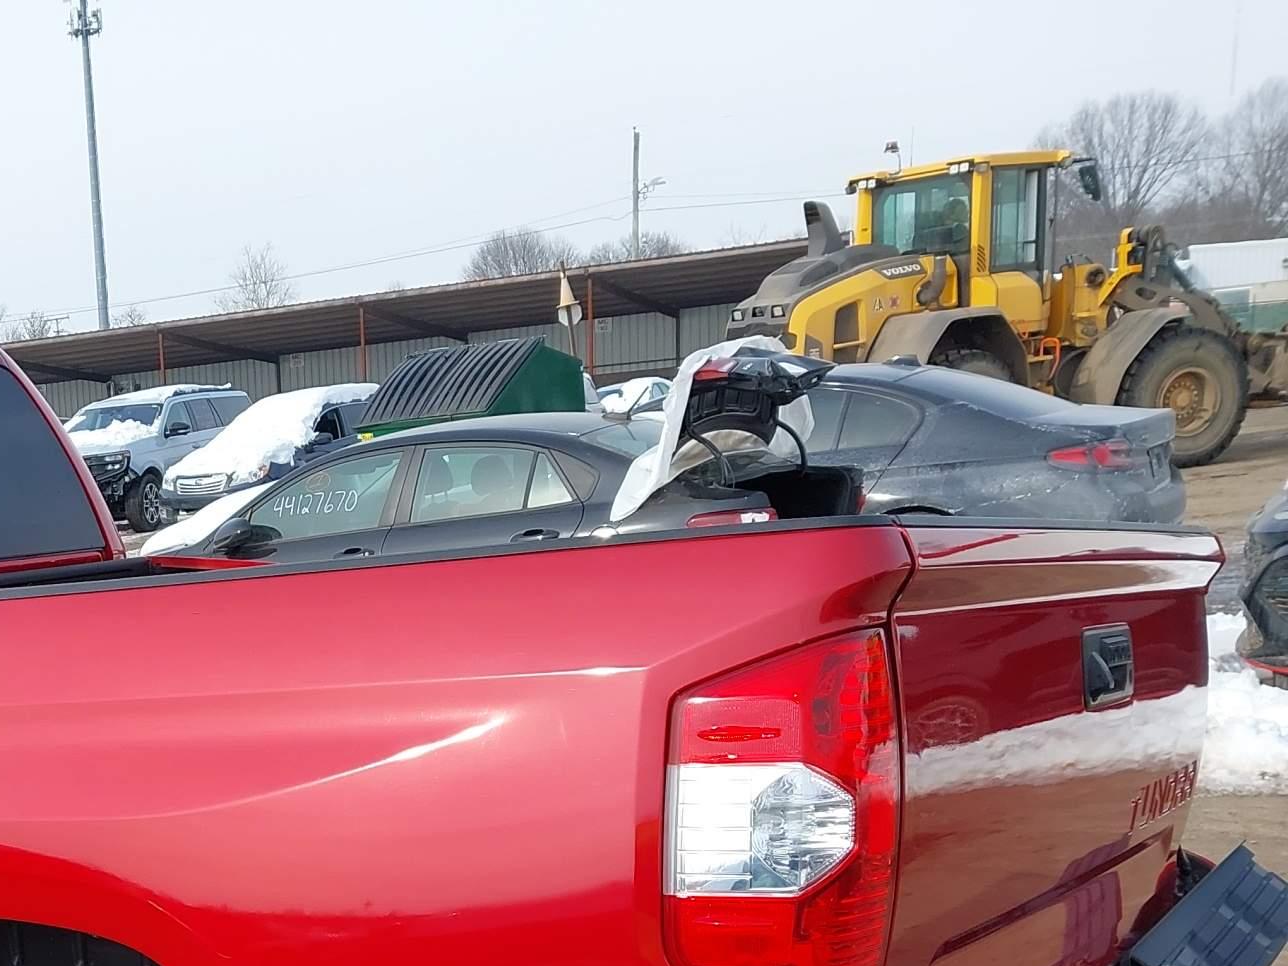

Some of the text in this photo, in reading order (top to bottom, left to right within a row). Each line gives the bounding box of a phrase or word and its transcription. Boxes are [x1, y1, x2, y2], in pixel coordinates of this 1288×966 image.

[881, 263, 922, 277] VOLVO
[273, 489, 358, 518] 44127670
[1128, 760, 1197, 835] TUNDRA
